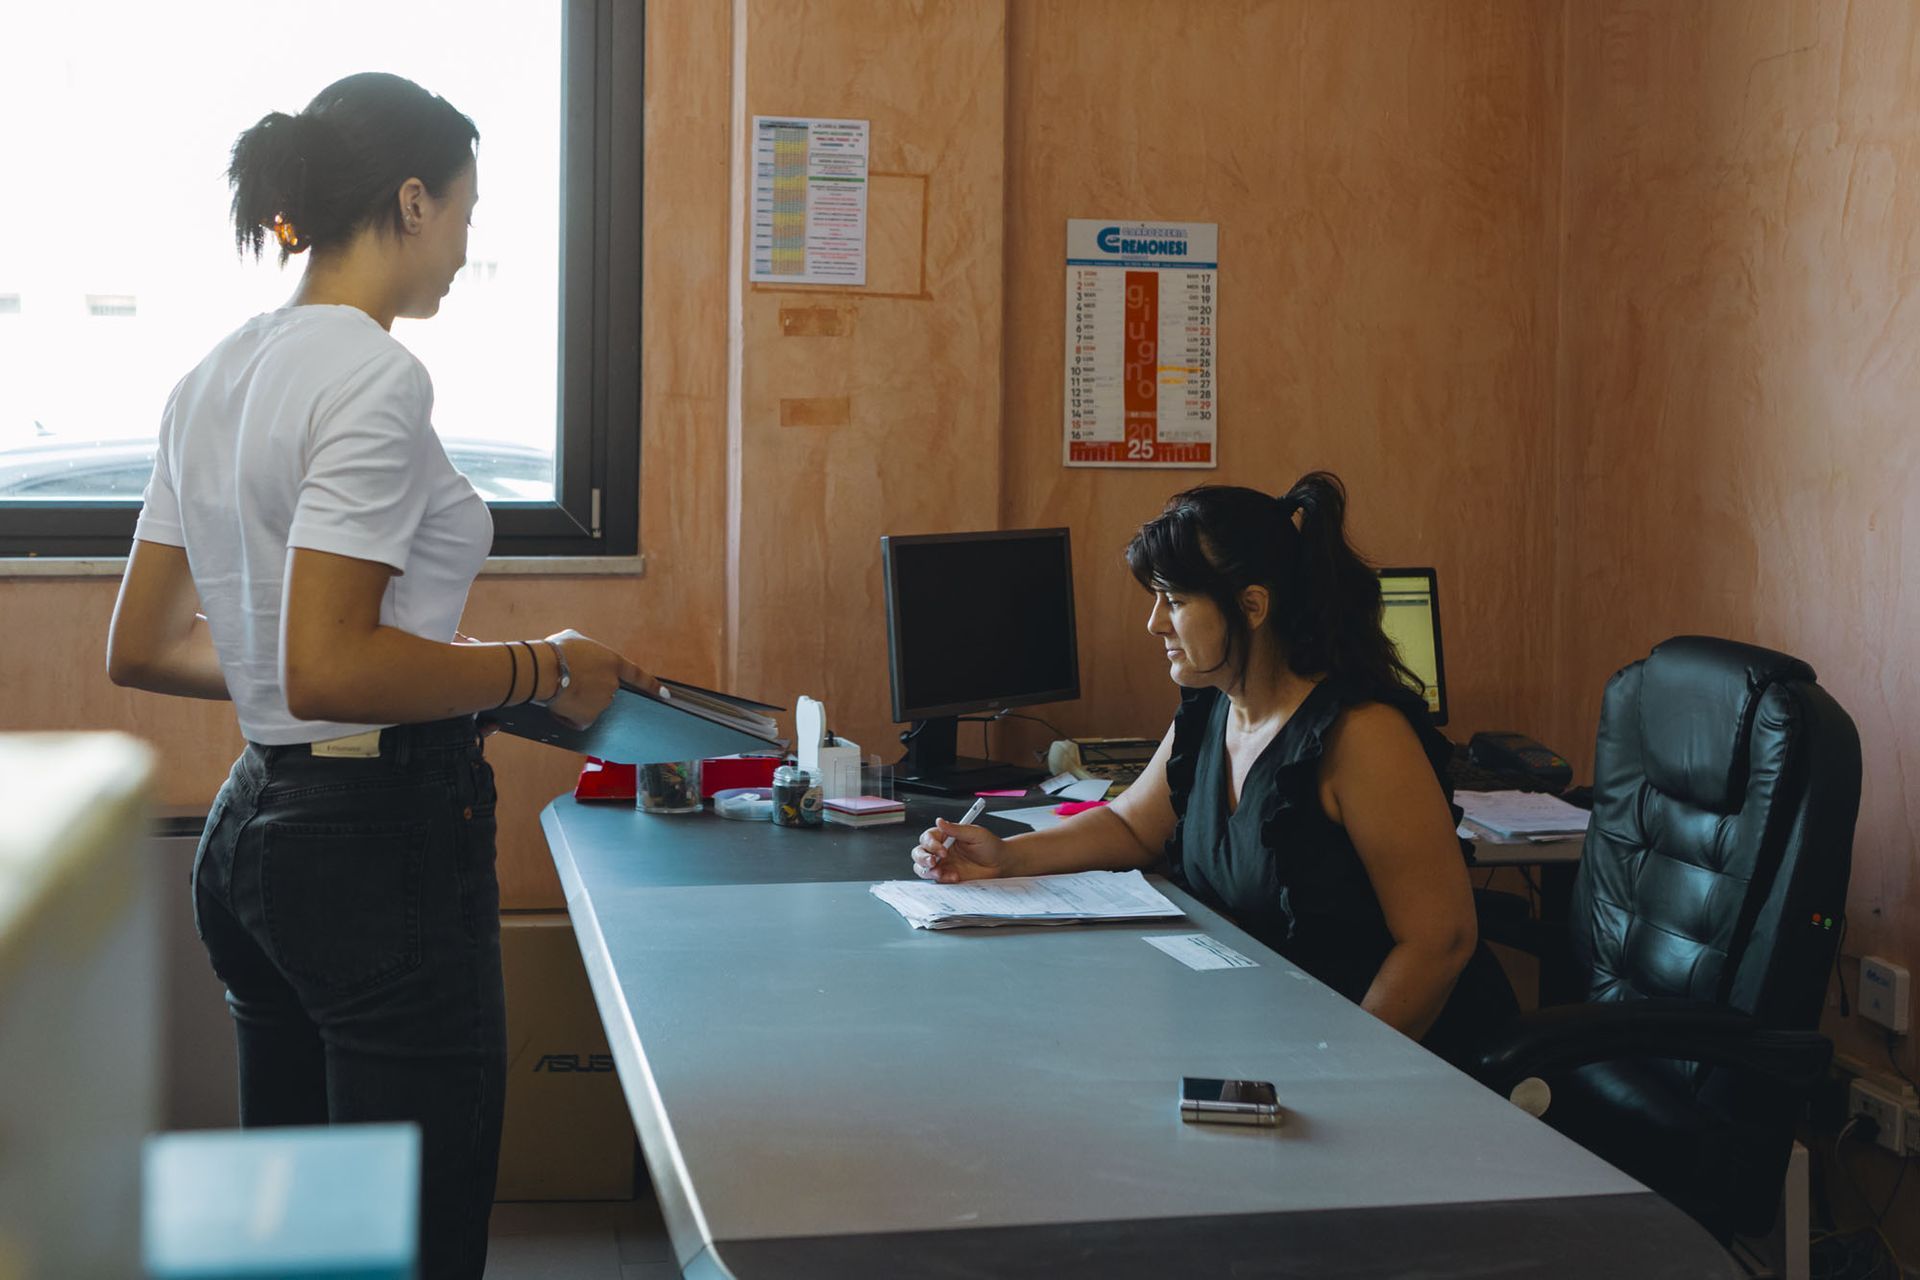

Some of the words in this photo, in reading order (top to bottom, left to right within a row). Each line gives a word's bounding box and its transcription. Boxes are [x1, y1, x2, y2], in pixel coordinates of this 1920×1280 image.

[1097, 227, 1187, 256] CREMONESI
[1201, 274, 1211, 283] 17
[1201, 285, 1210, 293] 18
[1201, 296, 1210, 304] 19
[1200, 306, 1211, 314] 20
[1200, 317, 1210, 325] 21
[1200, 337, 1210, 346] 23
[1200, 348, 1211, 356] 24
[1200, 359, 1210, 367] 25
[1071, 367, 1081, 375] 10
[1200, 369, 1210, 378] 26
[1071, 378, 1080, 386] 11
[1200, 380, 1210, 388] 27
[1071, 389, 1081, 397] 12
[1071, 399, 1081, 407] 13
[1200, 401, 1211, 409] 29
[1071, 410, 1081, 418] 14
[1200, 412, 1211, 420] 30
[1071, 431, 1081, 440] 16
[1128, 440, 1154, 459] 25
[533, 1054, 614, 1072] ASUS
